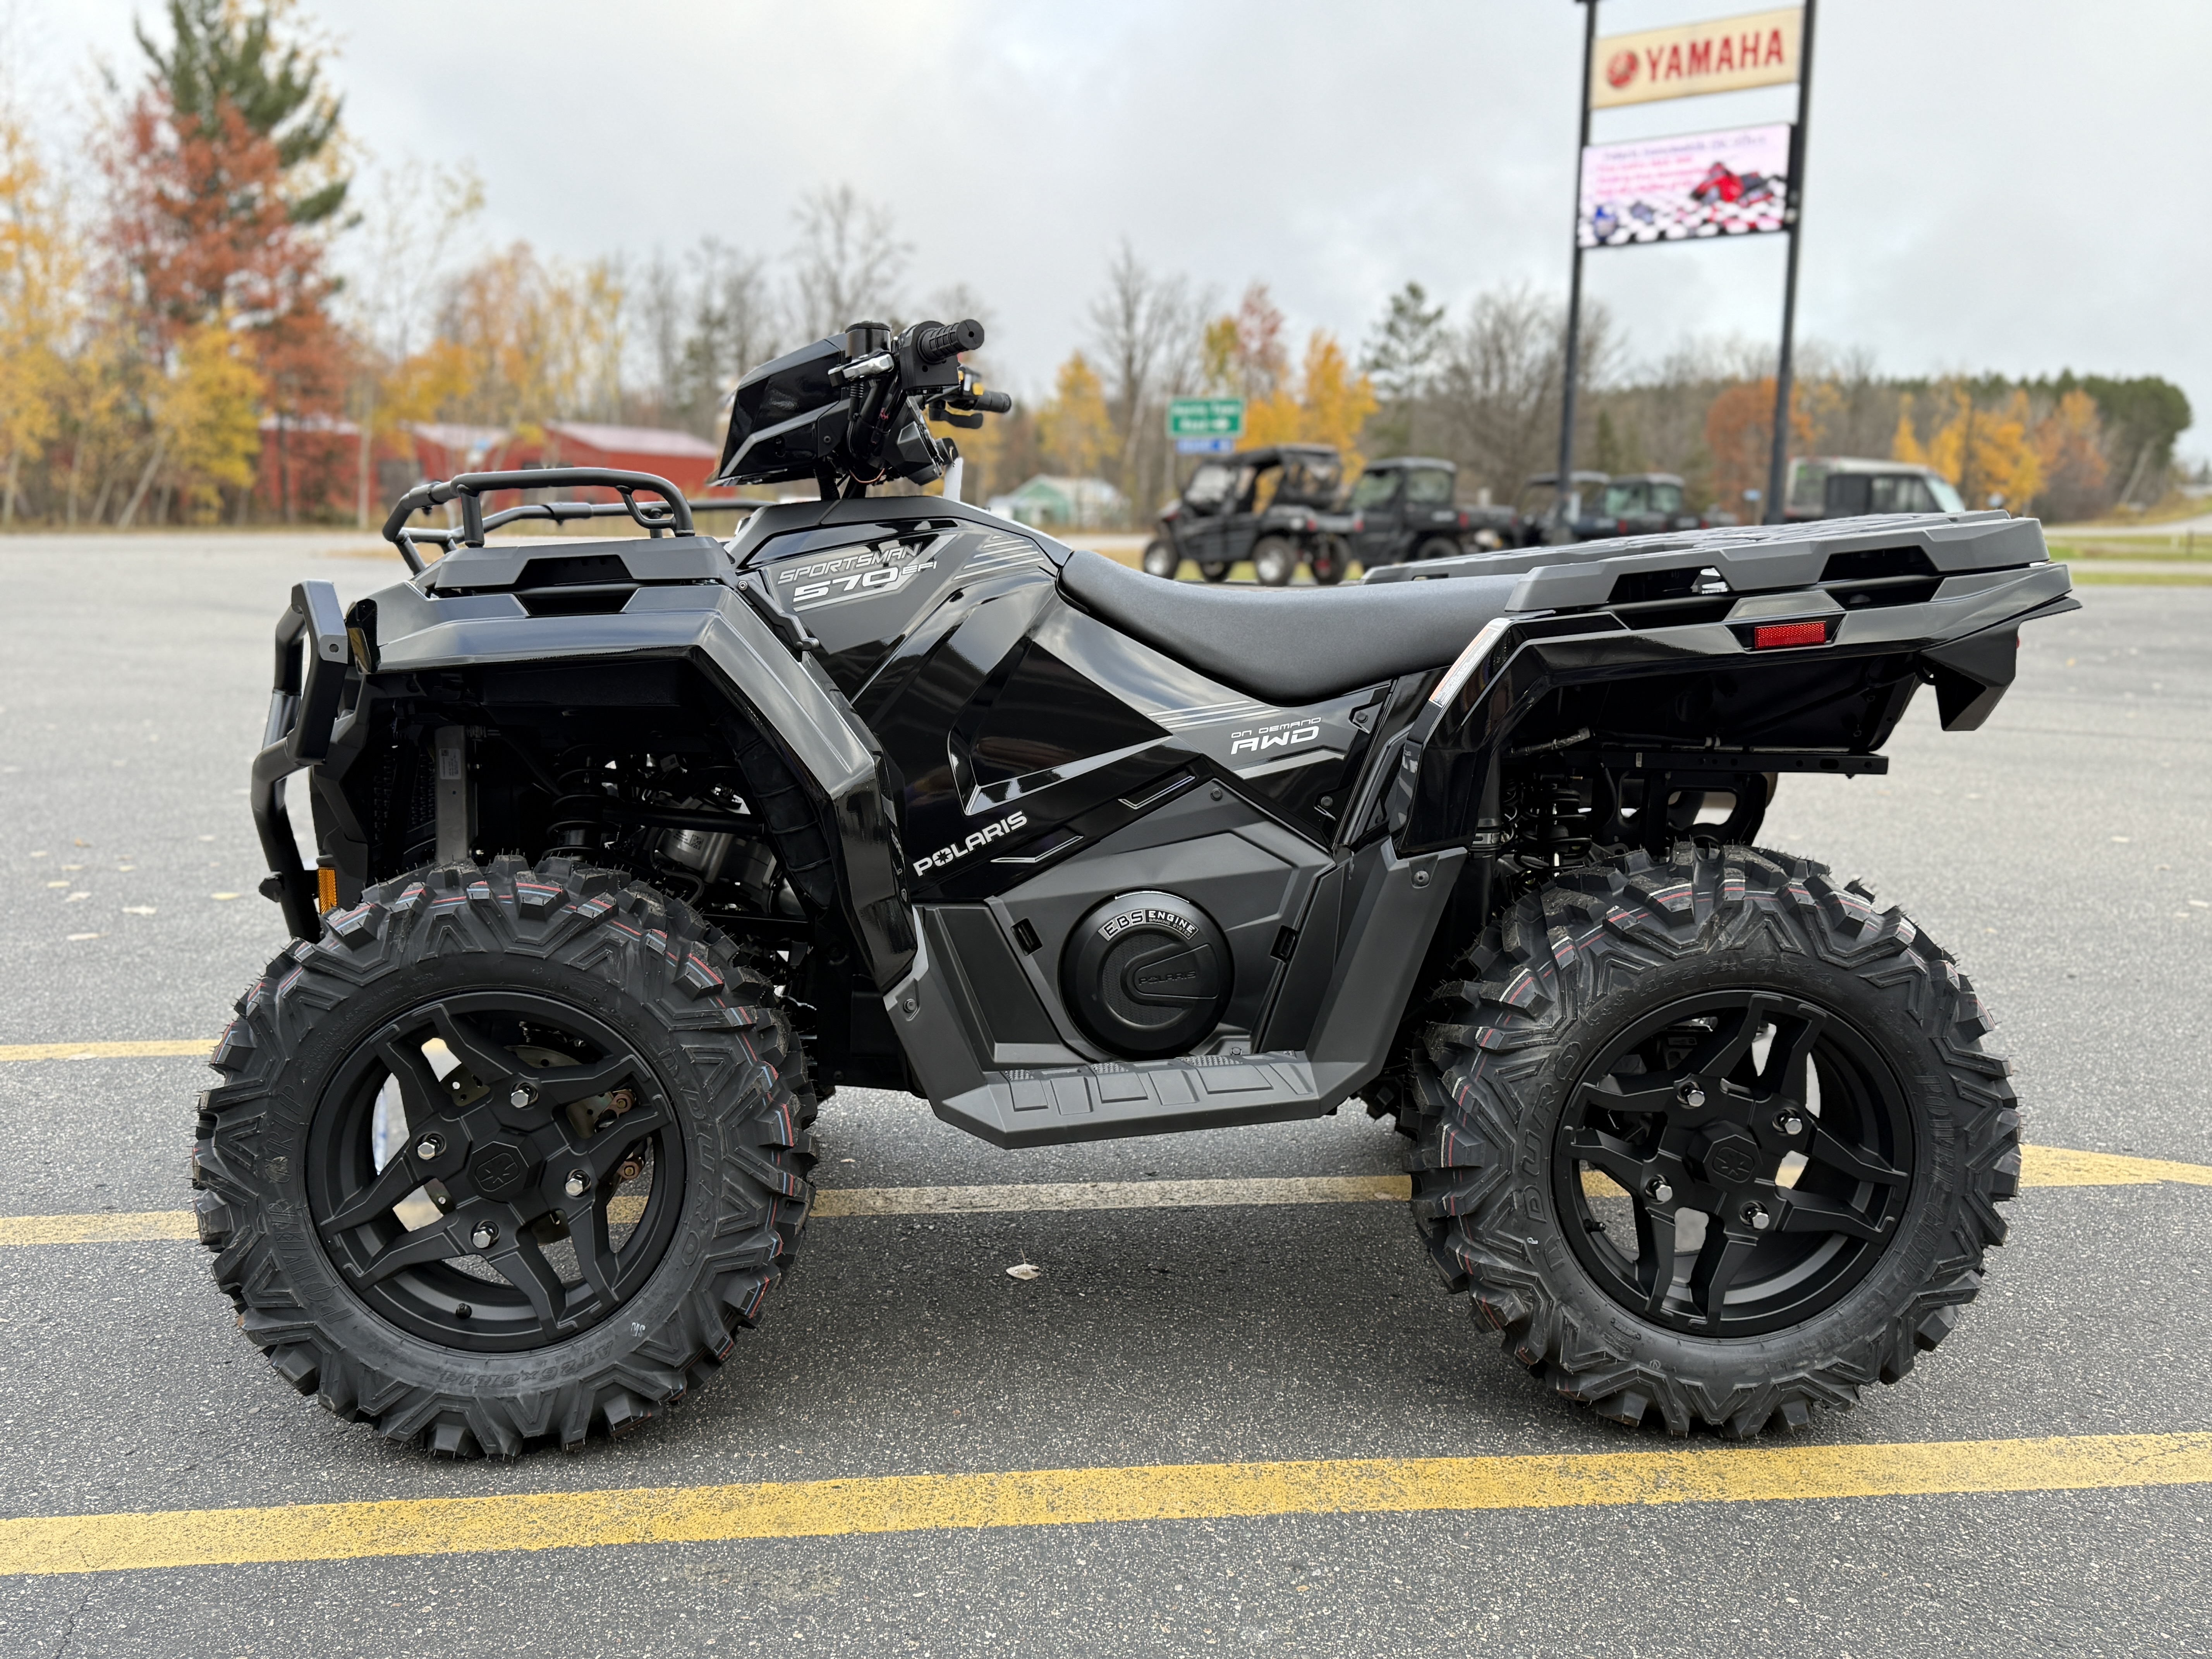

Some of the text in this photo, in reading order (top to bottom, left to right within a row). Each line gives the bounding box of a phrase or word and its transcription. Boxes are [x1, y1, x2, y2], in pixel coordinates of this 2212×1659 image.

[1646, 29, 1784, 82] YAMAHA
[779, 543, 922, 584] SPORTSMAN
[793, 561, 937, 602] 570 EFI
[1231, 717, 1321, 738] ON DEMAND
[1231, 726, 1319, 755] AWD
[913, 811, 1027, 877] POLARIS
[1104, 910, 1195, 938] EBS ENGINE
[1139, 970, 1196, 986] POLARIS
[1520, 1034, 1587, 1228] DURO
